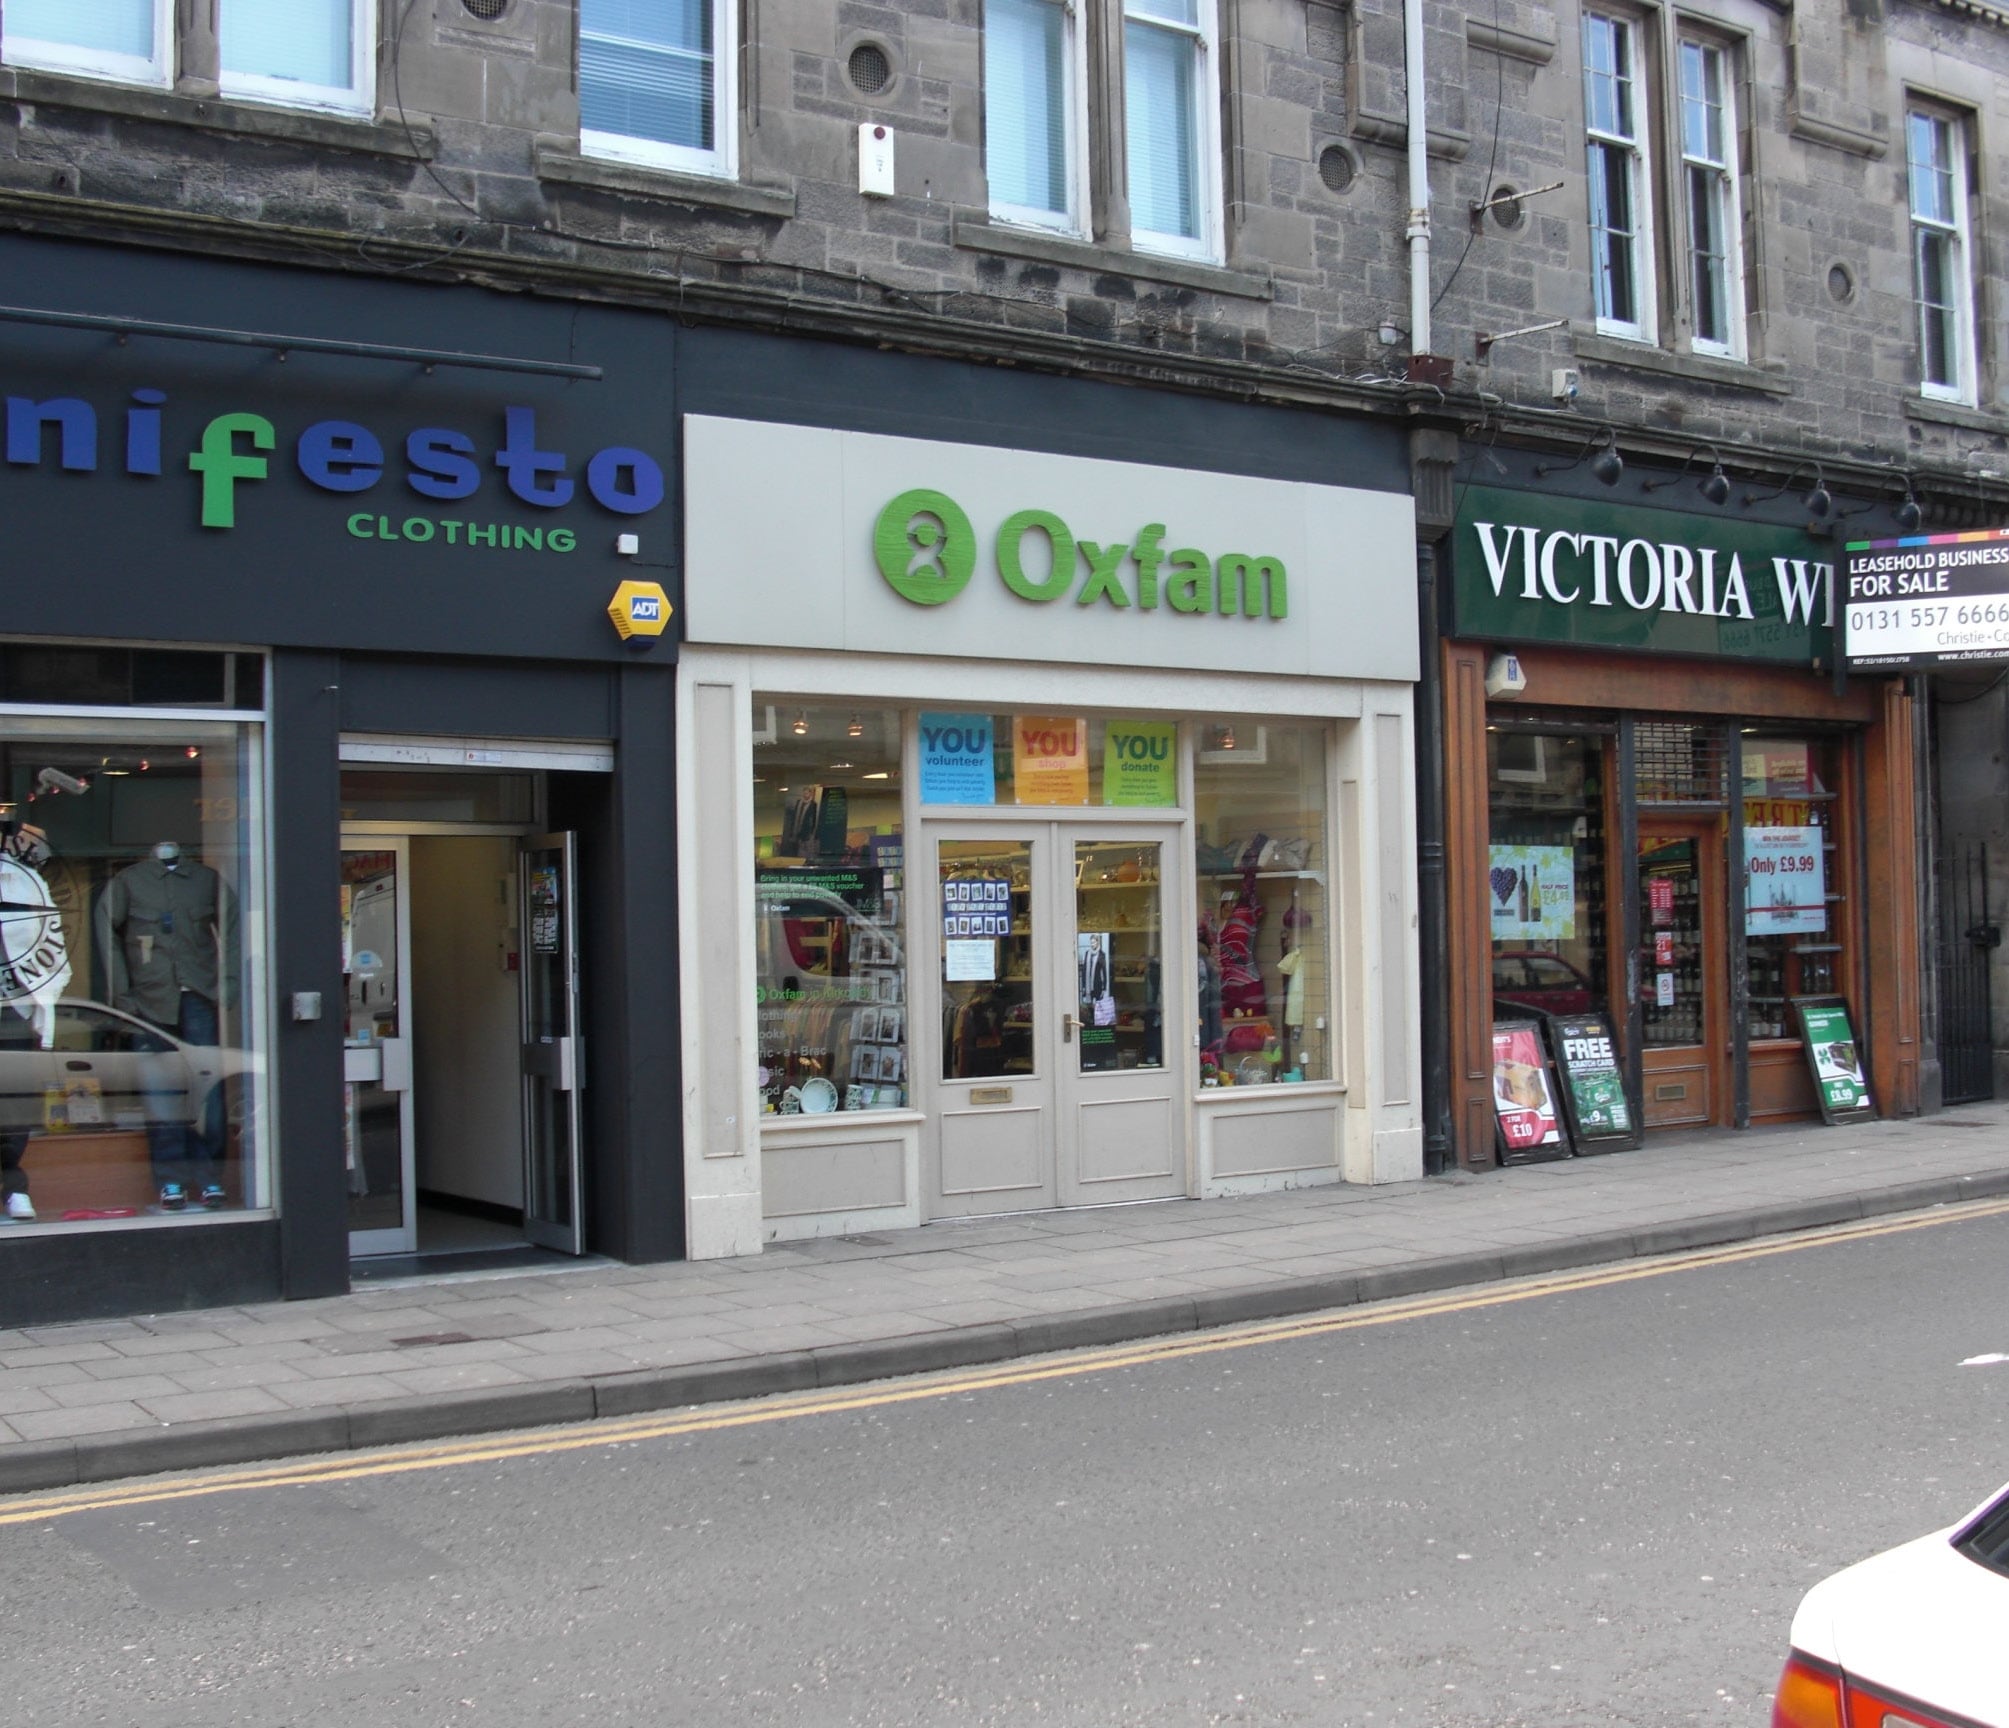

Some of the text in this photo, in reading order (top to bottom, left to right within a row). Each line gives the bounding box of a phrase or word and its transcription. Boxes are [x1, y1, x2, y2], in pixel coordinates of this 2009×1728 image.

[346, 513, 577, 553] CLOTHING
[996, 509, 1288, 619] Oxfam
[1473, 522, 1755, 619] VICTORIA
[1849, 548, 2009, 574] LEASEHOLD BUSINESS
[1850, 571, 1950, 597] FOR SALE
[632, 601, 660, 617] ADT
[1851, 602, 2009, 631] 0131 557 6666
[922, 727, 986, 754] YOU
[1022, 730, 1081, 757] YOU
[1112, 735, 1169, 761] YOU
[925, 755, 985, 767] volunteer
[1121, 762, 1160, 772] donate
[1751, 855, 1814, 876] Only £9.99
[769, 987, 806, 1000] Oxfam
[759, 1029, 786, 1040] ooks
[1563, 1037, 1614, 1060] FREE
[1511, 1123, 1533, 1138] £10
